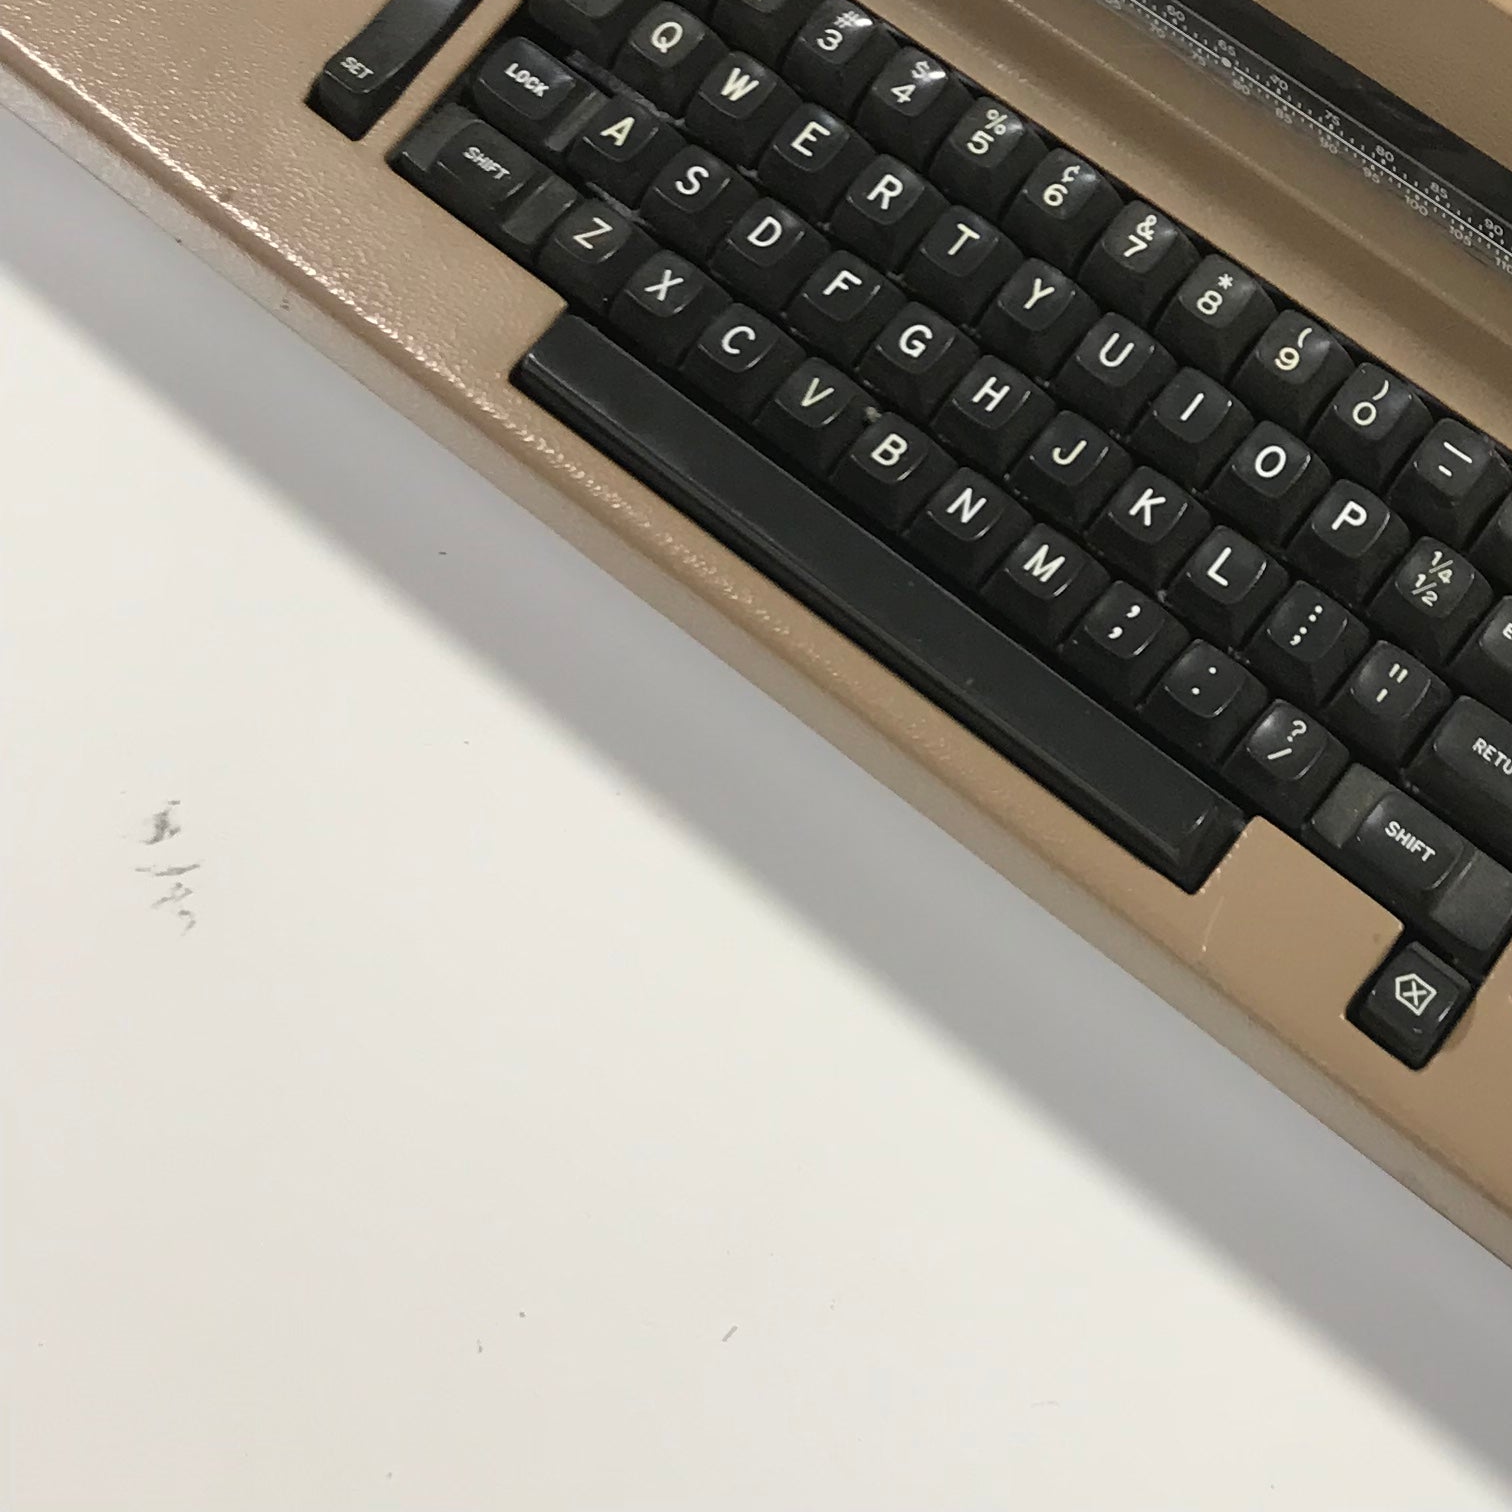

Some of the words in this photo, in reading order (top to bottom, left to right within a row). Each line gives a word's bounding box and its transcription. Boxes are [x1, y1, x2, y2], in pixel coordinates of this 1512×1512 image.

[833, 11, 860, 28] #
[652, 22, 682, 53] Q
[817, 29, 842, 50] 3
[341, 57, 373, 78] SET
[505, 63, 549, 96] LOCK
[912, 61, 931, 82] $
[721, 68, 759, 100] W
[891, 85, 916, 102] 4
[601, 117, 634, 145] A
[985, 110, 1011, 135] %
[791, 122, 830, 156] E
[967, 131, 994, 154] 5
[464, 147, 510, 179] SHIFT
[1324, 109, 1341, 127] 75
[1375, 145, 1395, 163] 80
[1430, 182, 1449, 199] 85
[1484, 218, 1504, 237] 90
[676, 166, 708, 194] S
[867, 175, 902, 209] R
[1044, 184, 1068, 206] 6
[573, 218, 612, 249] Z
[748, 217, 781, 246] D
[1137, 215, 1156, 240] &
[1404, 194, 1429, 217] 100
[1449, 225, 1472, 247] 105
[948, 224, 980, 255] T
[1124, 235, 1147, 257] 7
[645, 270, 683, 301] X
[824, 271, 862, 295] F
[1025, 279, 1054, 309] Y
[1197, 291, 1222, 314] 8
[722, 326, 755, 354] C
[900, 325, 932, 357] G
[1100, 333, 1134, 367] U
[1298, 328, 1312, 348] (
[1275, 348, 1299, 370] 9
[802, 378, 834, 406] V
[972, 377, 1009, 411] H
[1373, 380, 1388, 400] )
[1181, 393, 1204, 420] I
[1353, 402, 1376, 425] 0
[872, 434, 907, 465] B
[1053, 441, 1086, 464] J
[1255, 446, 1286, 477] O
[947, 488, 986, 523] N
[1130, 489, 1165, 526] K
[1332, 501, 1366, 530] P
[1024, 545, 1065, 582] M
[1208, 548, 1231, 586] L
[1287, 720, 1306, 742] ?
[1268, 748, 1292, 759] /
[1385, 821, 1435, 861] SHIFT
